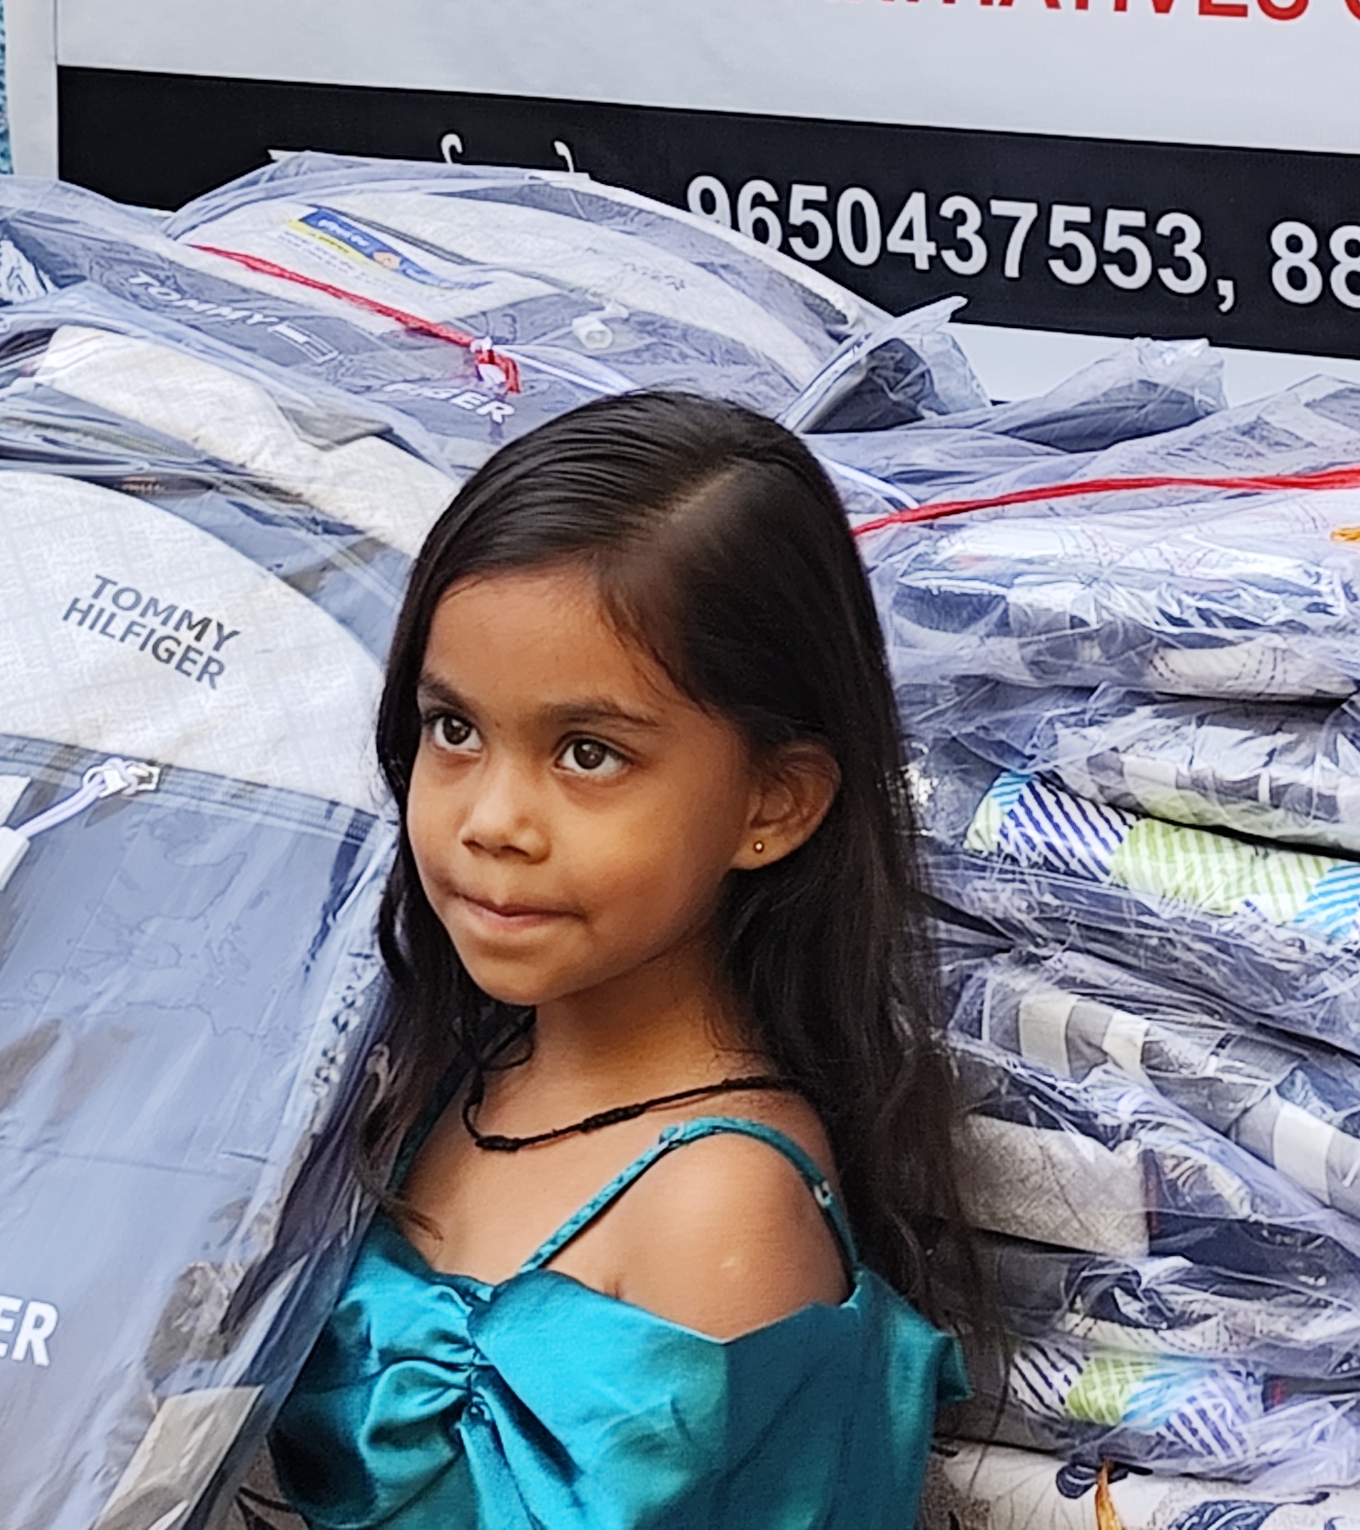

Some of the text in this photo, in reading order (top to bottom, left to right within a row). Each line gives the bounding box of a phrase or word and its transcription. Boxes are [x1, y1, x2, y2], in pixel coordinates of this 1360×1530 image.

[127, 271, 280, 327] TOMMY
[61, 596, 227, 691] HILFIGER
[94, 573, 241, 654] TOMMY
